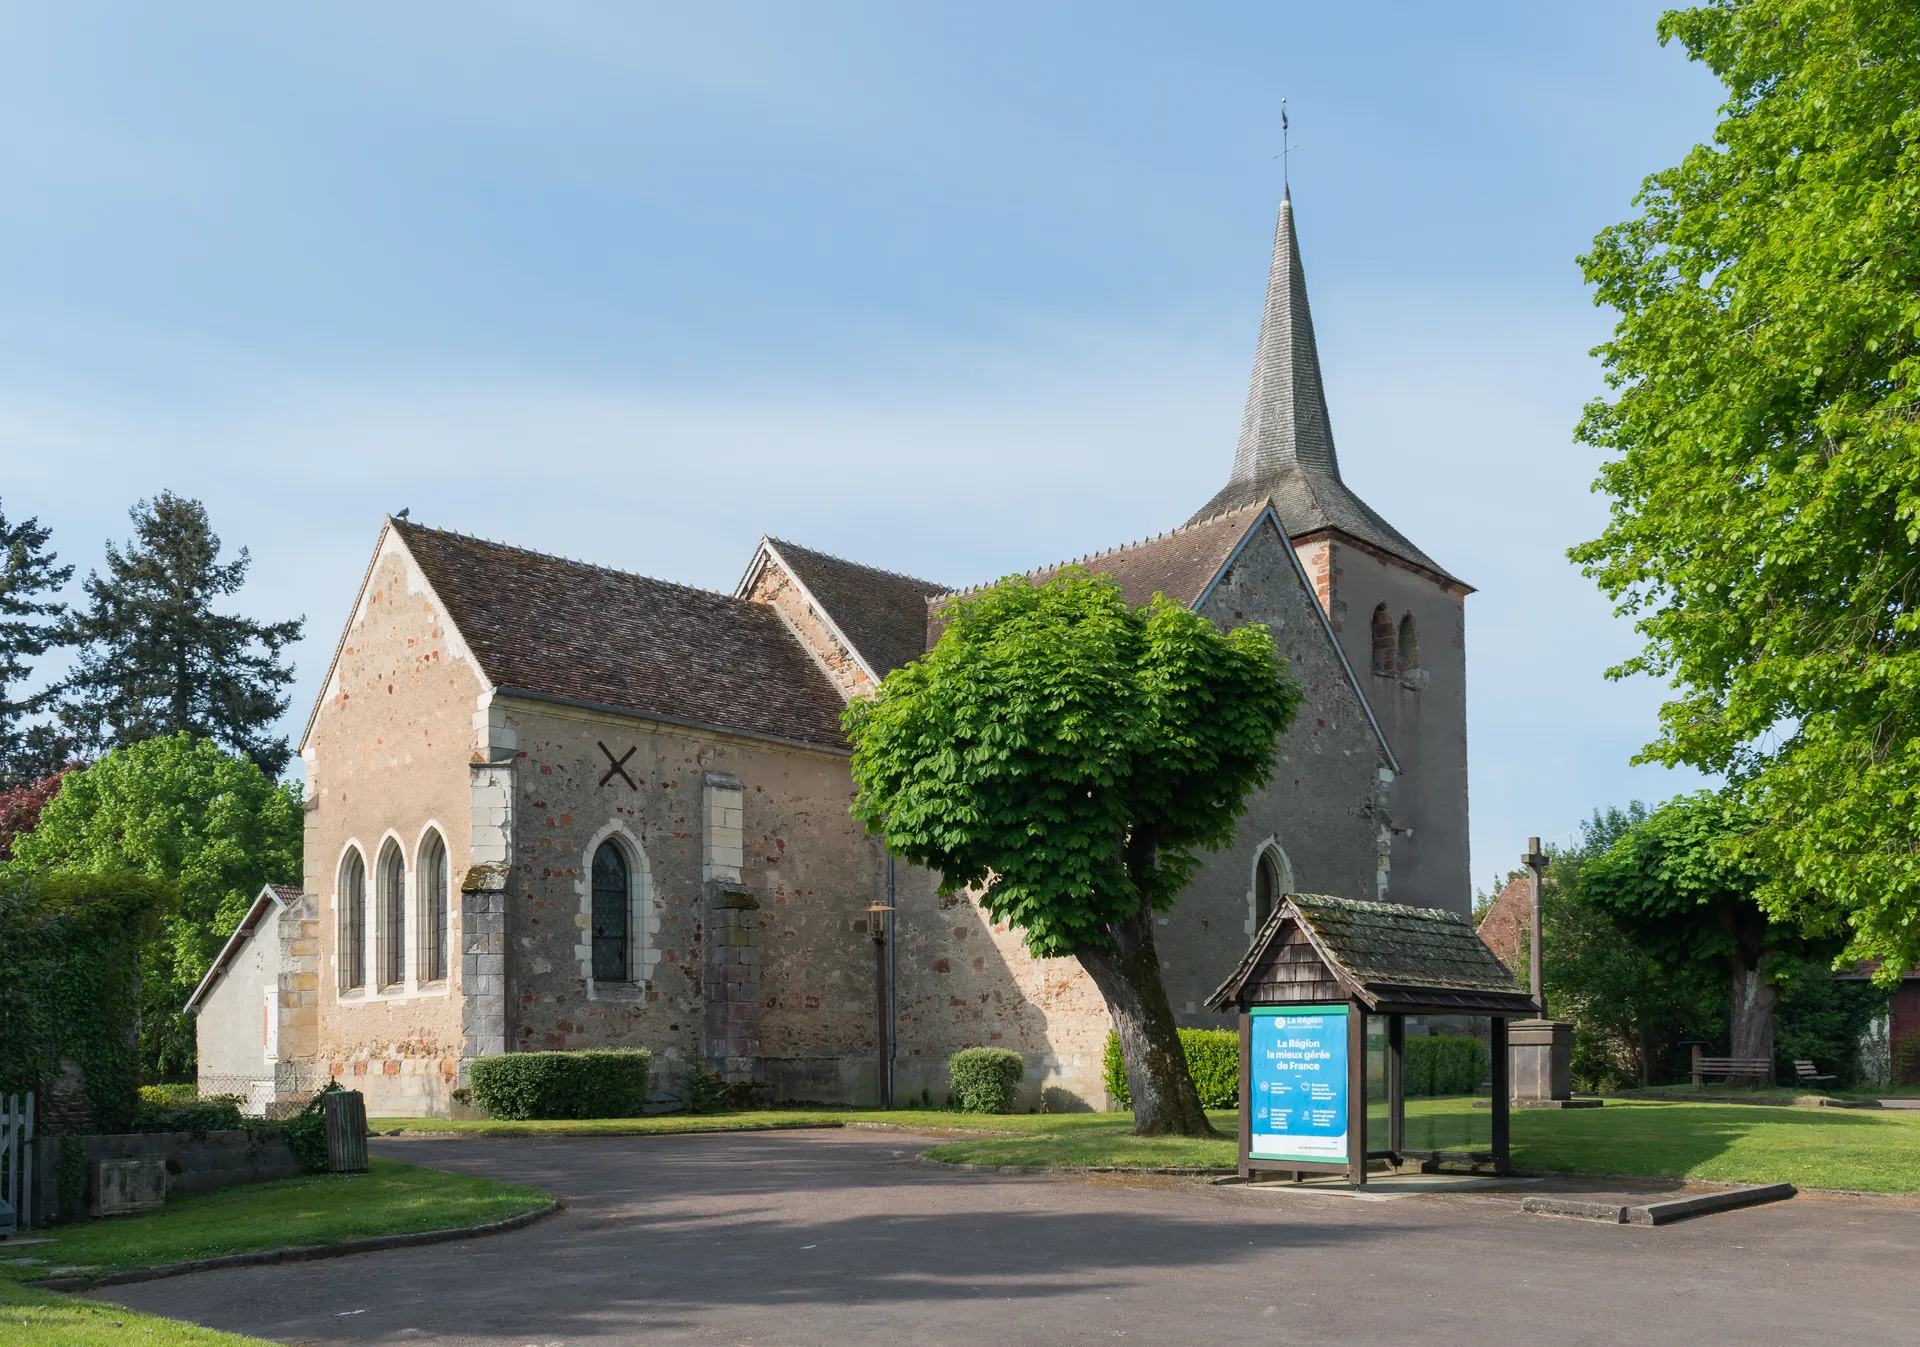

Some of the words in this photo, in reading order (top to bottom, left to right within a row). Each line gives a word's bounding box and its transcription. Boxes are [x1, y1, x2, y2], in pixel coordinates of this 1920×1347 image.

[1277, 1039, 1287, 1048] La
[1289, 1039, 1320, 1049] Région
[1267, 1050, 1275, 1059] la
[1276, 1050, 1302, 1059] mieux
[1304, 1050, 1330, 1060] gérée
[1277, 1061, 1288, 1070] de
[1290, 1062, 1320, 1070] France
